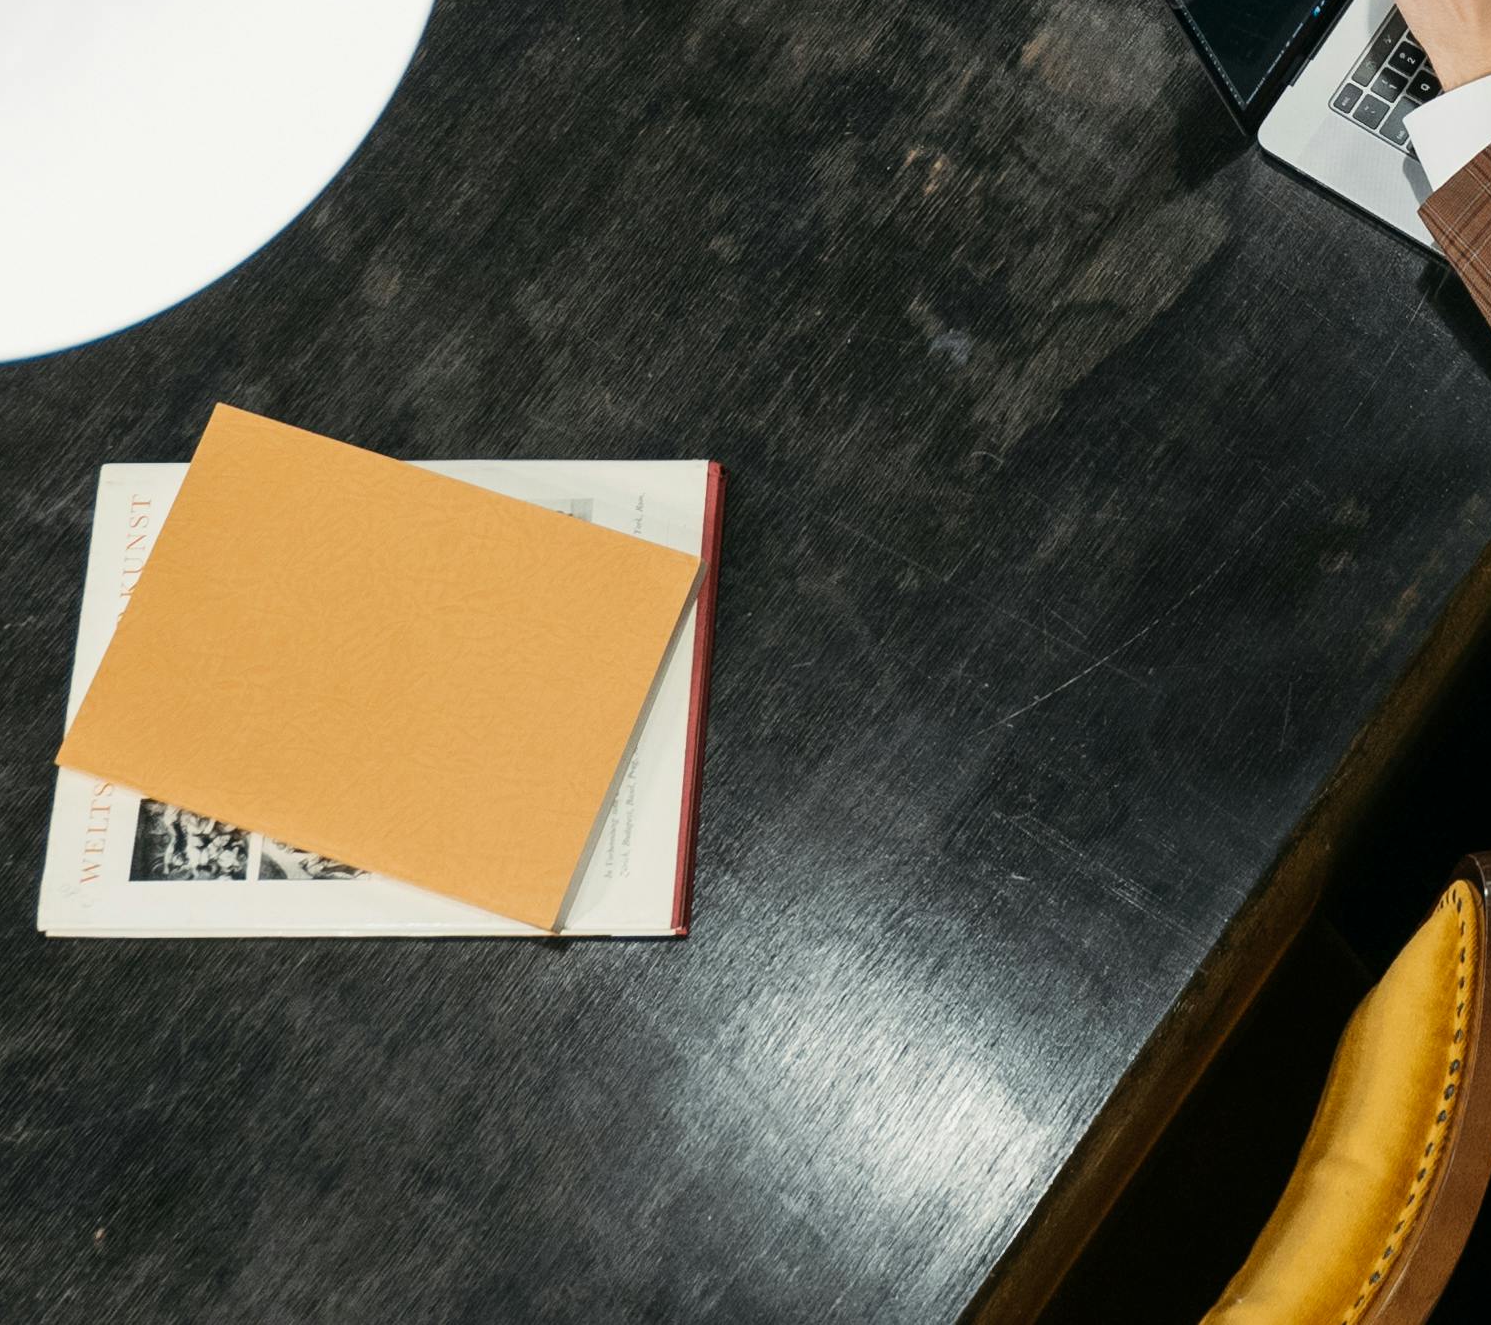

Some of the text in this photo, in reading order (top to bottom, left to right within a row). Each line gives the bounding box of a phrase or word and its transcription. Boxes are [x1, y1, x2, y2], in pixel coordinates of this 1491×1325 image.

[115, 493, 152, 601] KUNST
[621, 807, 636, 847] Budapest,
[626, 781, 639, 806] Basel,
[76, 780, 116, 887] WELTS
